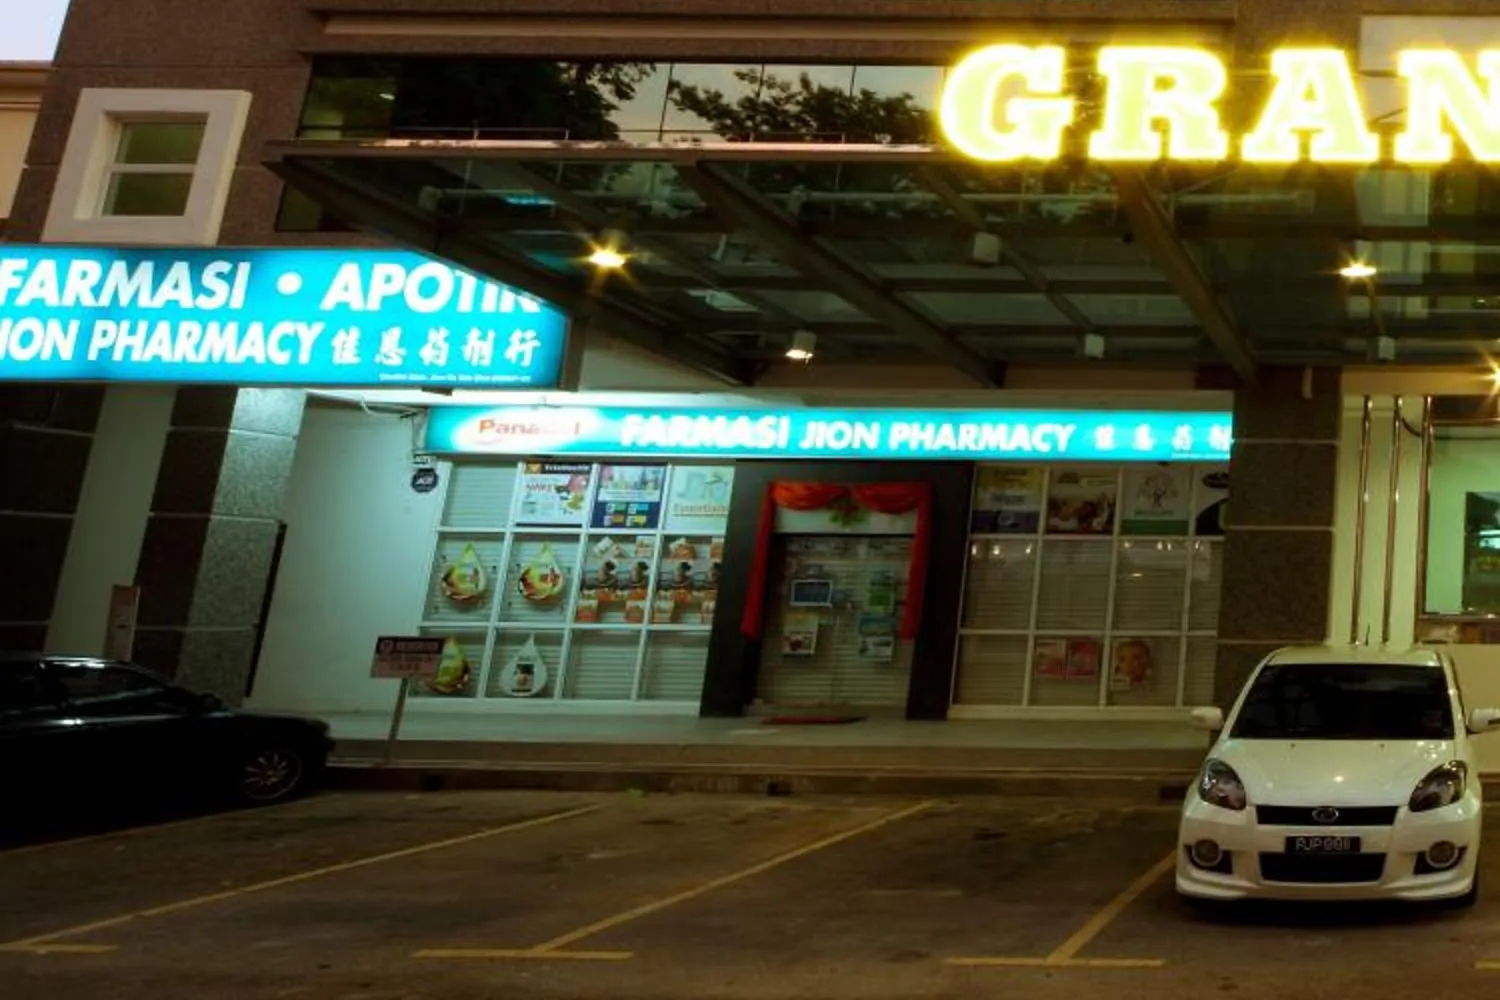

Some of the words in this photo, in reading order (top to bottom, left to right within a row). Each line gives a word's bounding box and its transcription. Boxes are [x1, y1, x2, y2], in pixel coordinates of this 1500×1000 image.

[0, 257, 252, 311] FARMASI
[87, 318, 326, 366] PHARMACY
[478, 417, 581, 437] Panal
[619, 413, 791, 449] FARMASI
[800, 420, 881, 450] JION
[888, 422, 1076, 452] PHARMACY
